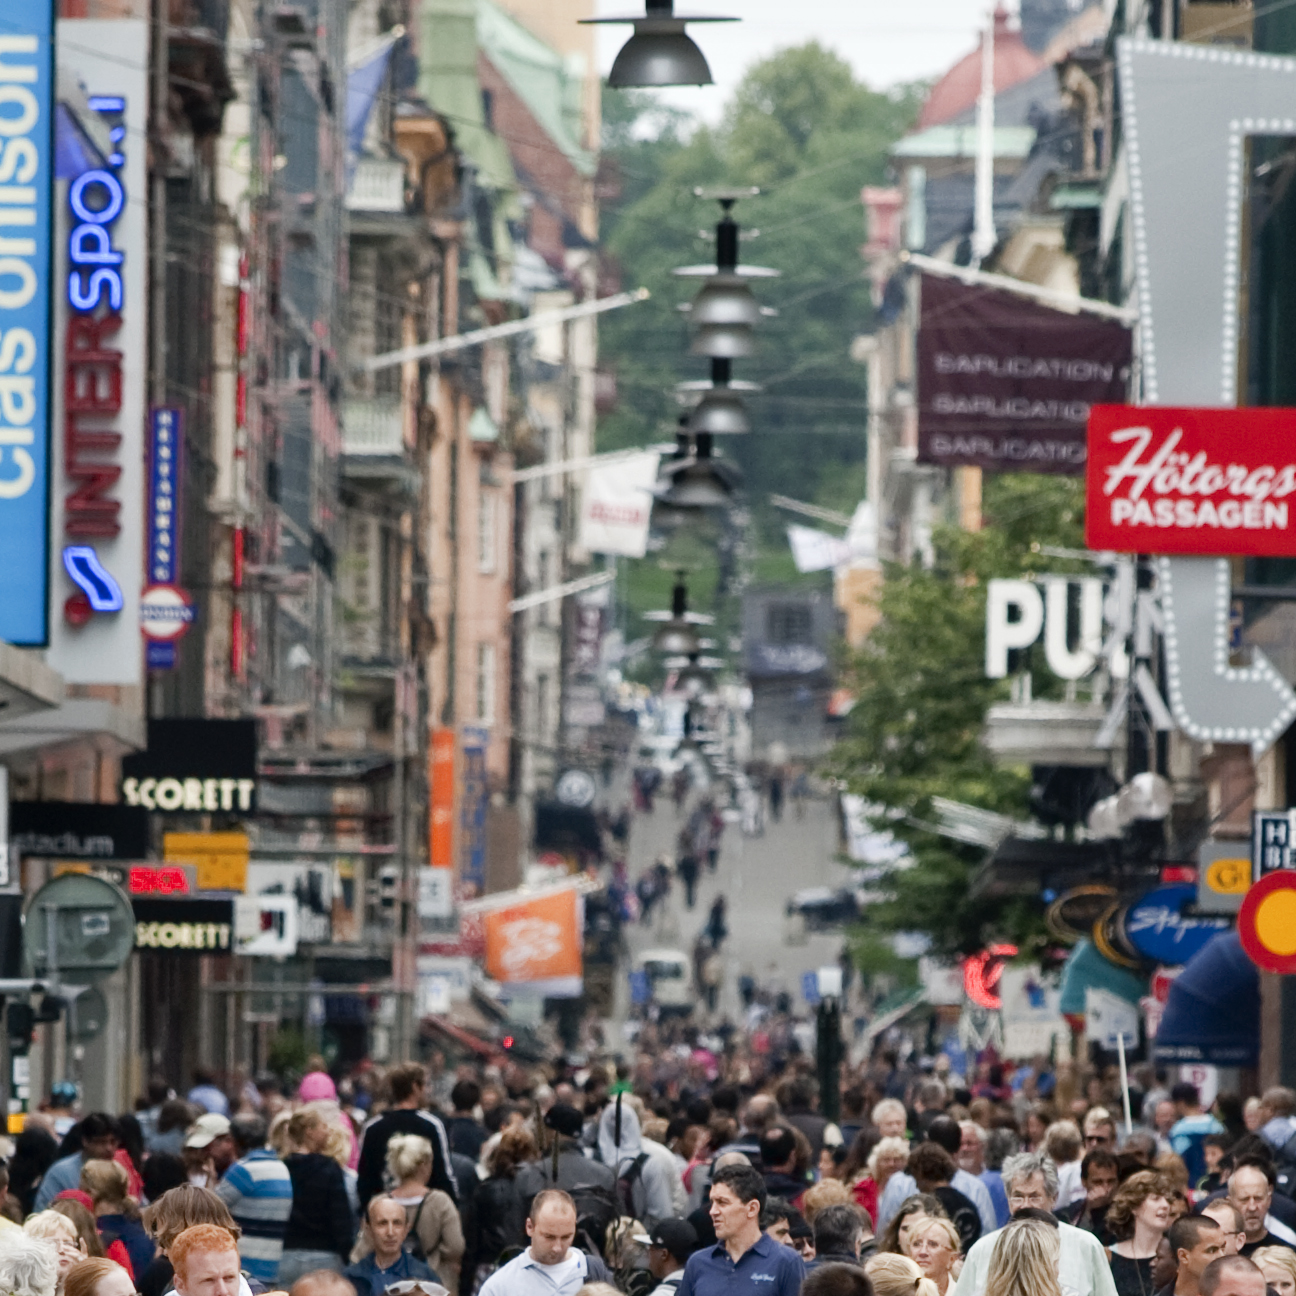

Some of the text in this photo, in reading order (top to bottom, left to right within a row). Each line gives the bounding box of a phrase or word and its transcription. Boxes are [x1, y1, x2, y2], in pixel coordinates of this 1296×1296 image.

[65, 97, 125, 537] INTERSPO
[1110, 498, 1288, 529] PASSAGEN
[985, 577, 1132, 679] PU
[123, 777, 254, 811] SCORETT
[137, 922, 230, 949] SCORETT
